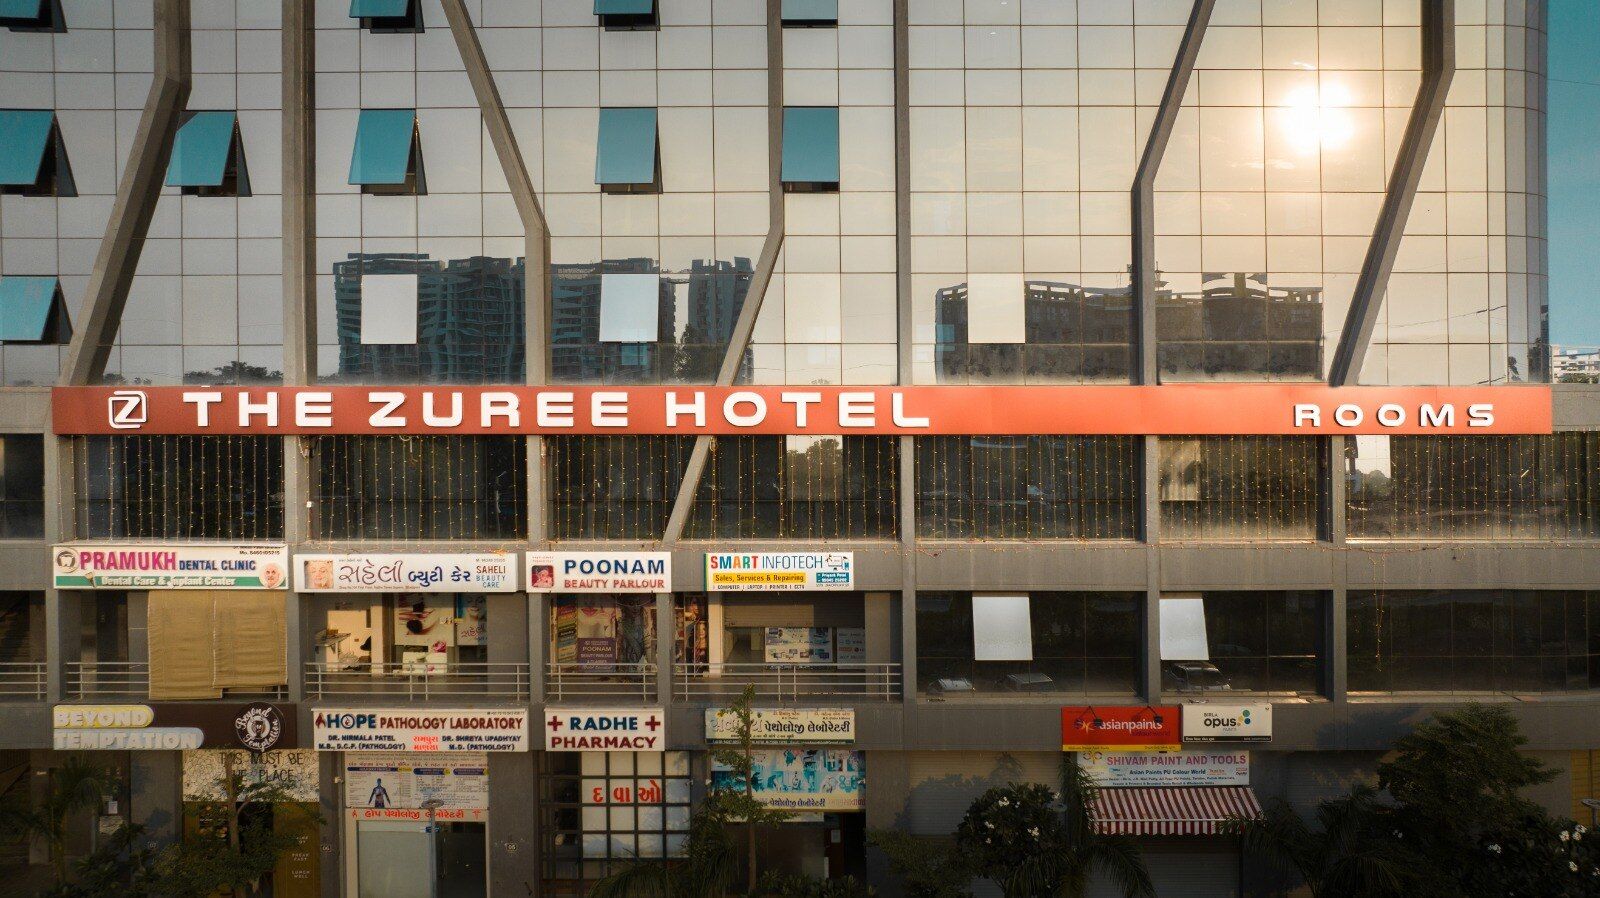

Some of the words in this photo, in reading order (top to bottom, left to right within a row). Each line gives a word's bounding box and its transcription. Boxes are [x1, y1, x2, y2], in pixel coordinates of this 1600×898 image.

[183, 391, 332, 427] THE
[368, 391, 628, 427] ZUREE
[665, 391, 930, 427] HOTEL
[1294, 403, 1495, 427] ROOMS
[80, 551, 177, 570] PRAMUKH
[179, 560, 217, 571] DENTAL
[221, 559, 256, 571] CLINIC
[564, 559, 665, 575] POONAM
[710, 555, 759, 570] SMART
[762, 555, 823, 570] INFOTECH
[338, 558, 404, 584] સહેલી
[476, 565, 506, 574] SAHELI
[101, 576, 132, 586] Dental
[134, 576, 156, 586] Care
[157, 577, 167, 586] &
[205, 576, 236, 586] Center
[408, 566, 443, 587] બ્યુટી
[450, 566, 471, 582] કેર
[715, 574, 735, 583] Sales,
[737, 574, 764, 582] Services
[773, 574, 804, 583] Repairing
[482, 581, 501, 589] CARE
[564, 579, 609, 589] BEAUTY
[613, 579, 665, 589] PARLOUR
[54, 709, 151, 727] BEYOND
[327, 714, 377, 730] HOPE
[380, 717, 447, 731] PATHOLOGY
[450, 717, 523, 730] LABORATORY
[570, 717, 638, 731] RADHE
[1204, 717, 1237, 729] opus
[764, 720, 805, 734] પેથોલોજી
[807, 719, 850, 733] લેબોરેટરી
[1099, 719, 1163, 733] asianpaints
[54, 731, 199, 750] TEMPTATION
[358, 743, 406, 751] (PATHOLOGY)
[467, 743, 515, 751] (PATHOLOGY)
[551, 736, 657, 749] PHARMACY
[288, 752, 304, 765] BE
[1106, 756, 1148, 766] SHIVAM
[1151, 756, 1183, 766] PAINT
[1186, 755, 1208, 765] AND
[1212, 755, 1247, 765] TOOLS
[364, 809, 381, 819] હોપ
